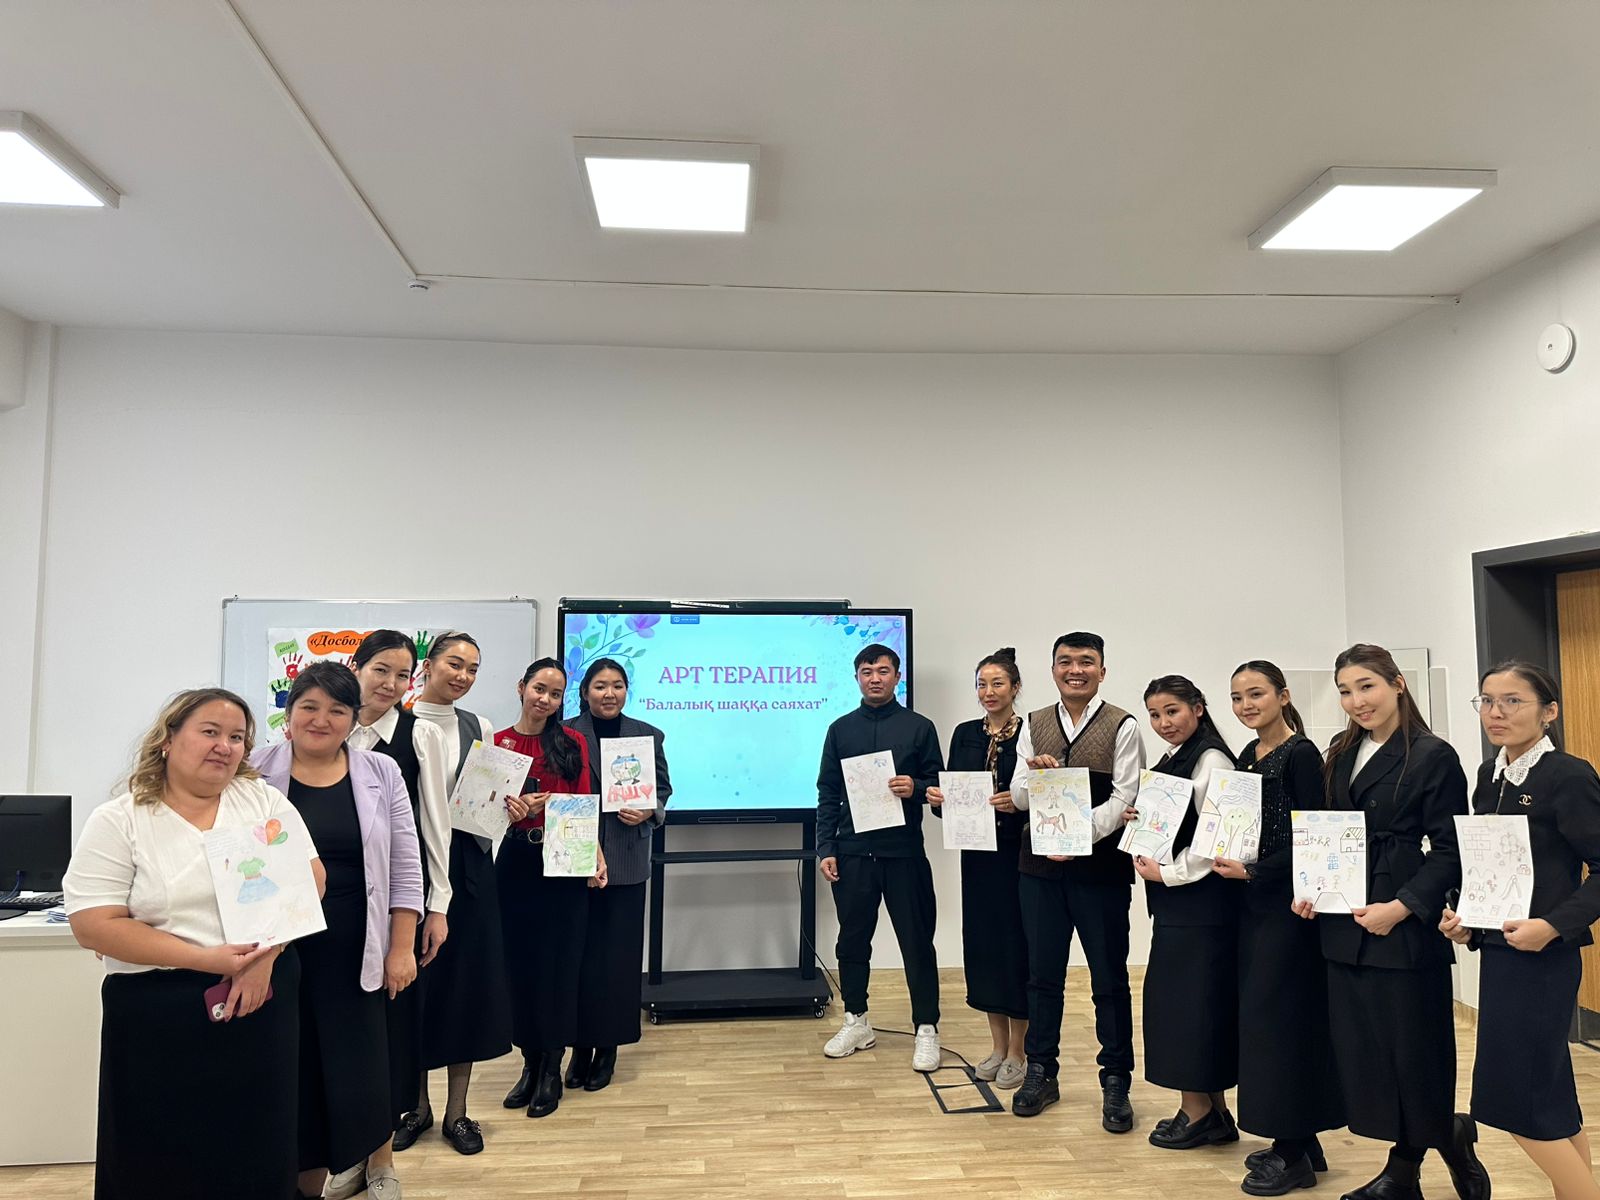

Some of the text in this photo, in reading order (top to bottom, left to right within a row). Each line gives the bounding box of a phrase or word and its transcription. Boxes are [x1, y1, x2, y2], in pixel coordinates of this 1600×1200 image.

[658, 666, 817, 684] АРТ ТЕРАПИЯ
[717, 701, 768, 712] шаққа
